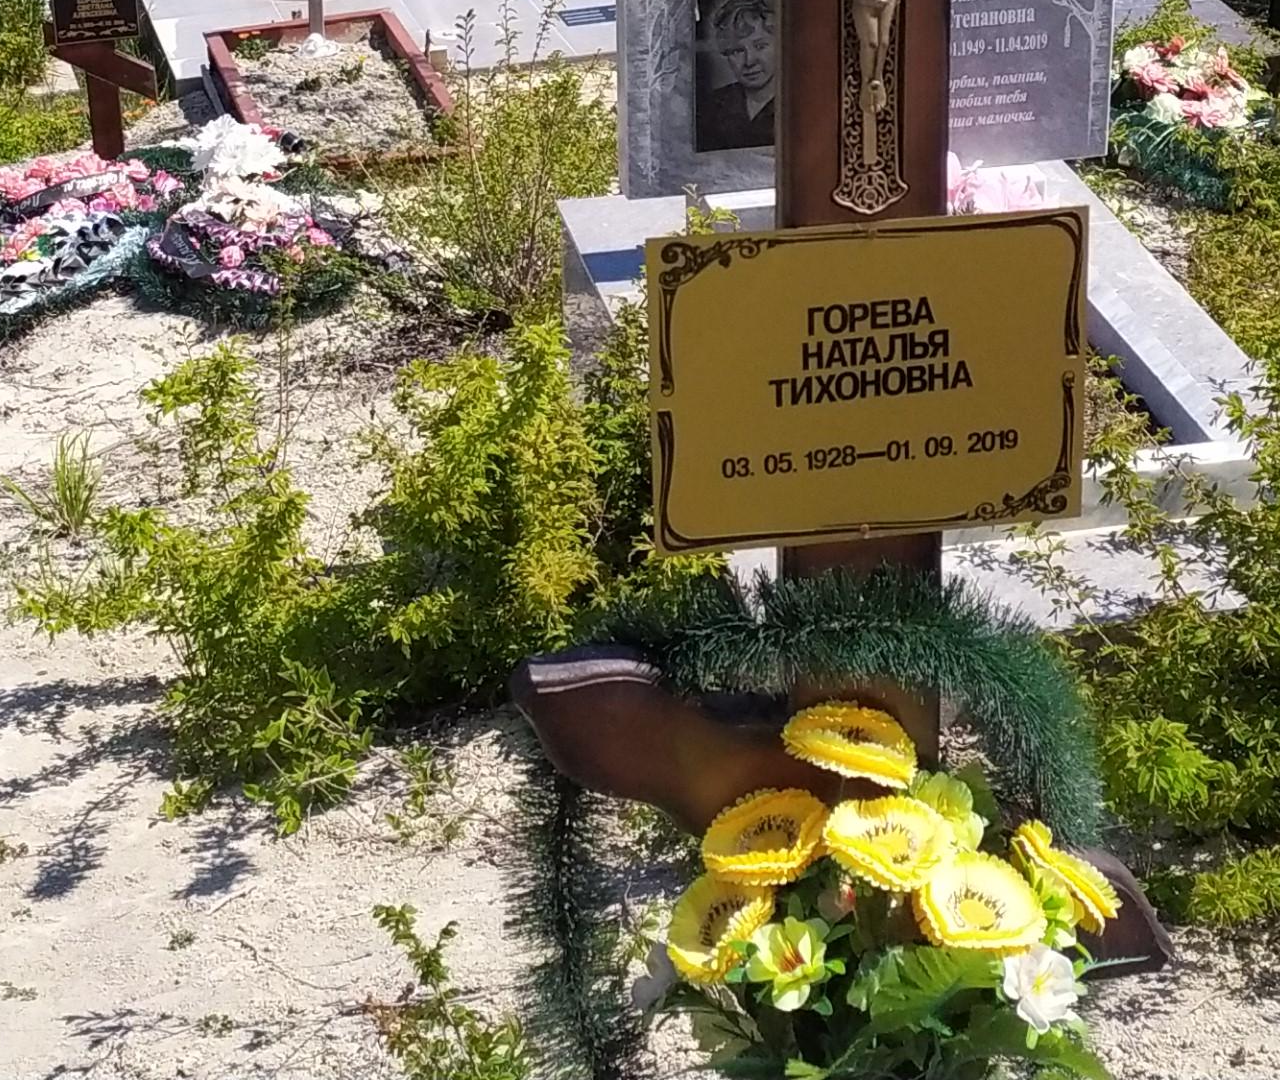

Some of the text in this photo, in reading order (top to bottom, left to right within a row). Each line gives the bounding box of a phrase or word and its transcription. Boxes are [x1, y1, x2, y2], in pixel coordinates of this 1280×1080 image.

[806, 296, 936, 337] ГОРЕВА
[801, 328, 950, 371] НАТАЛЬЯ
[768, 360, 973, 408] ТИХОНОВНА
[721, 457, 756, 479] 03.
[763, 452, 798, 475] 05.
[924, 435, 959, 458] 09.
[967, 429, 1019, 454] 2019
